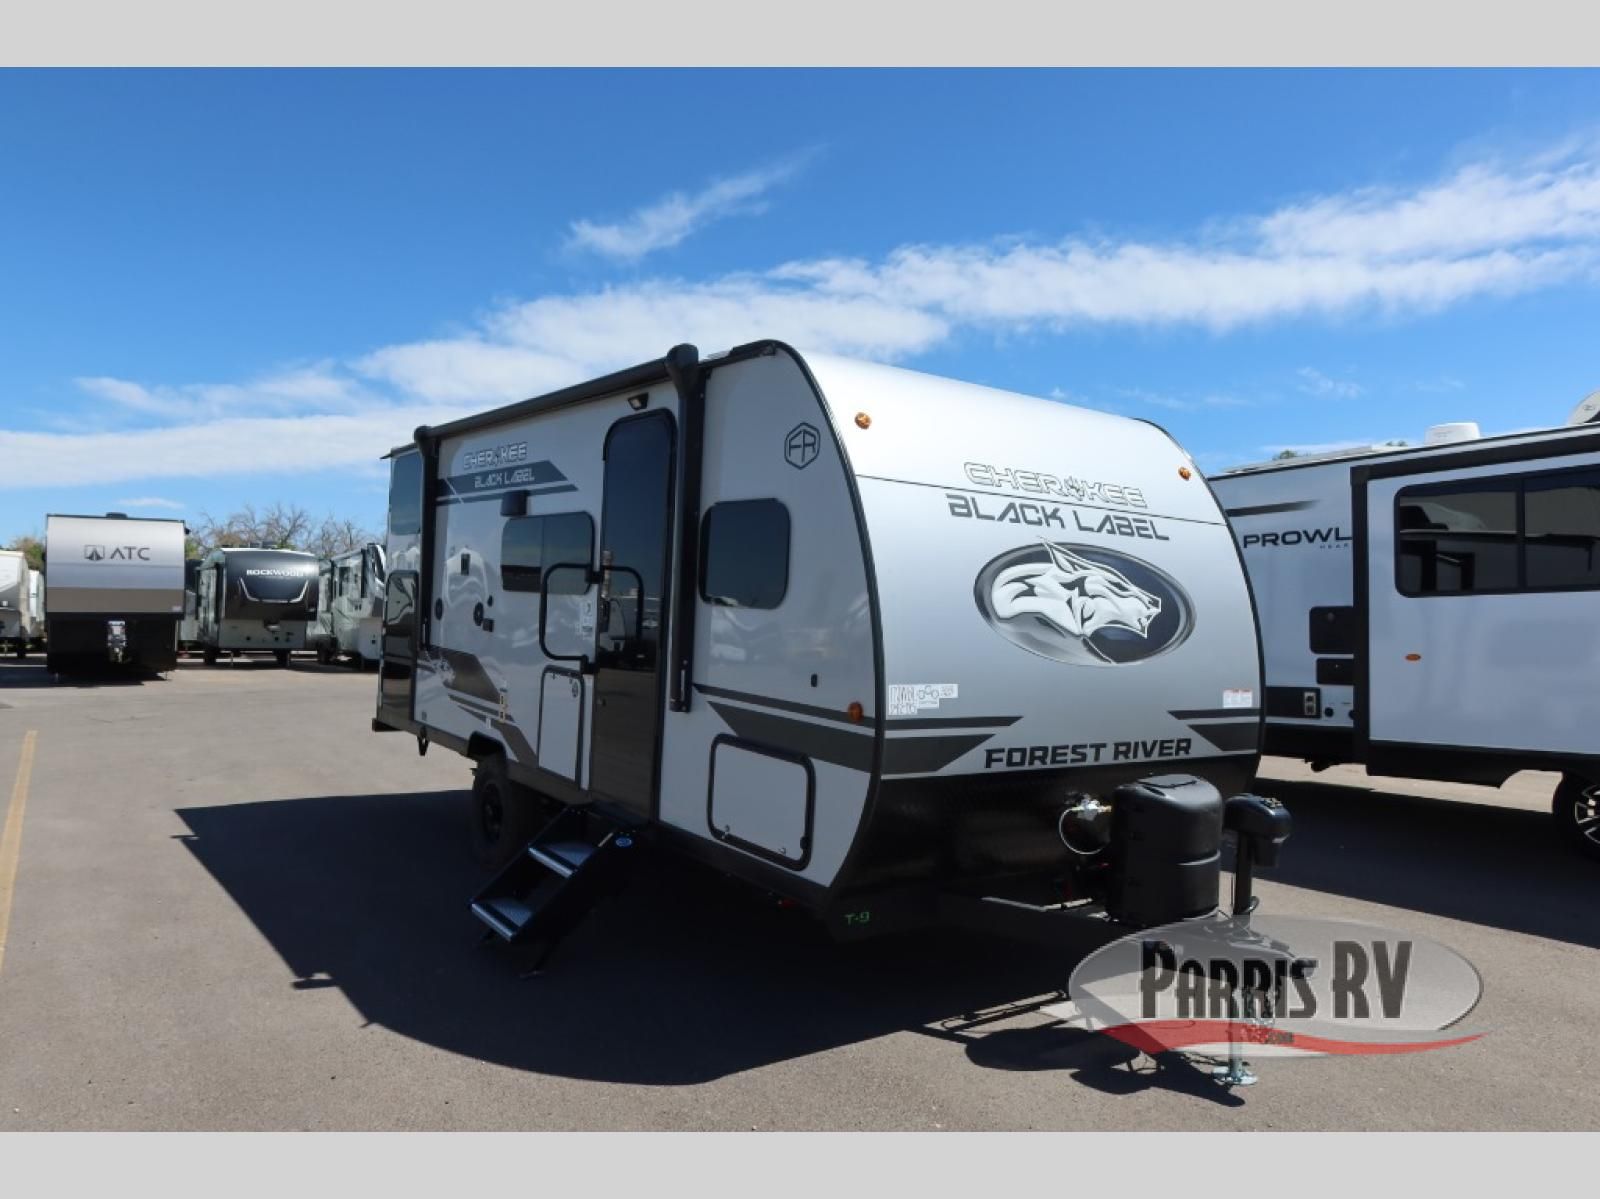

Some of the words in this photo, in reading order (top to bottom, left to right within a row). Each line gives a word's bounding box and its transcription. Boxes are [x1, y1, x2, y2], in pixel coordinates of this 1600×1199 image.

[964, 462, 1147, 508] CHEROKEE
[946, 493, 1065, 529] BLACK
[1072, 510, 1170, 541] LABEL
[110, 546, 150, 561] ATC
[984, 743, 1107, 769] FOREST
[1113, 738, 1192, 760] RIVER
